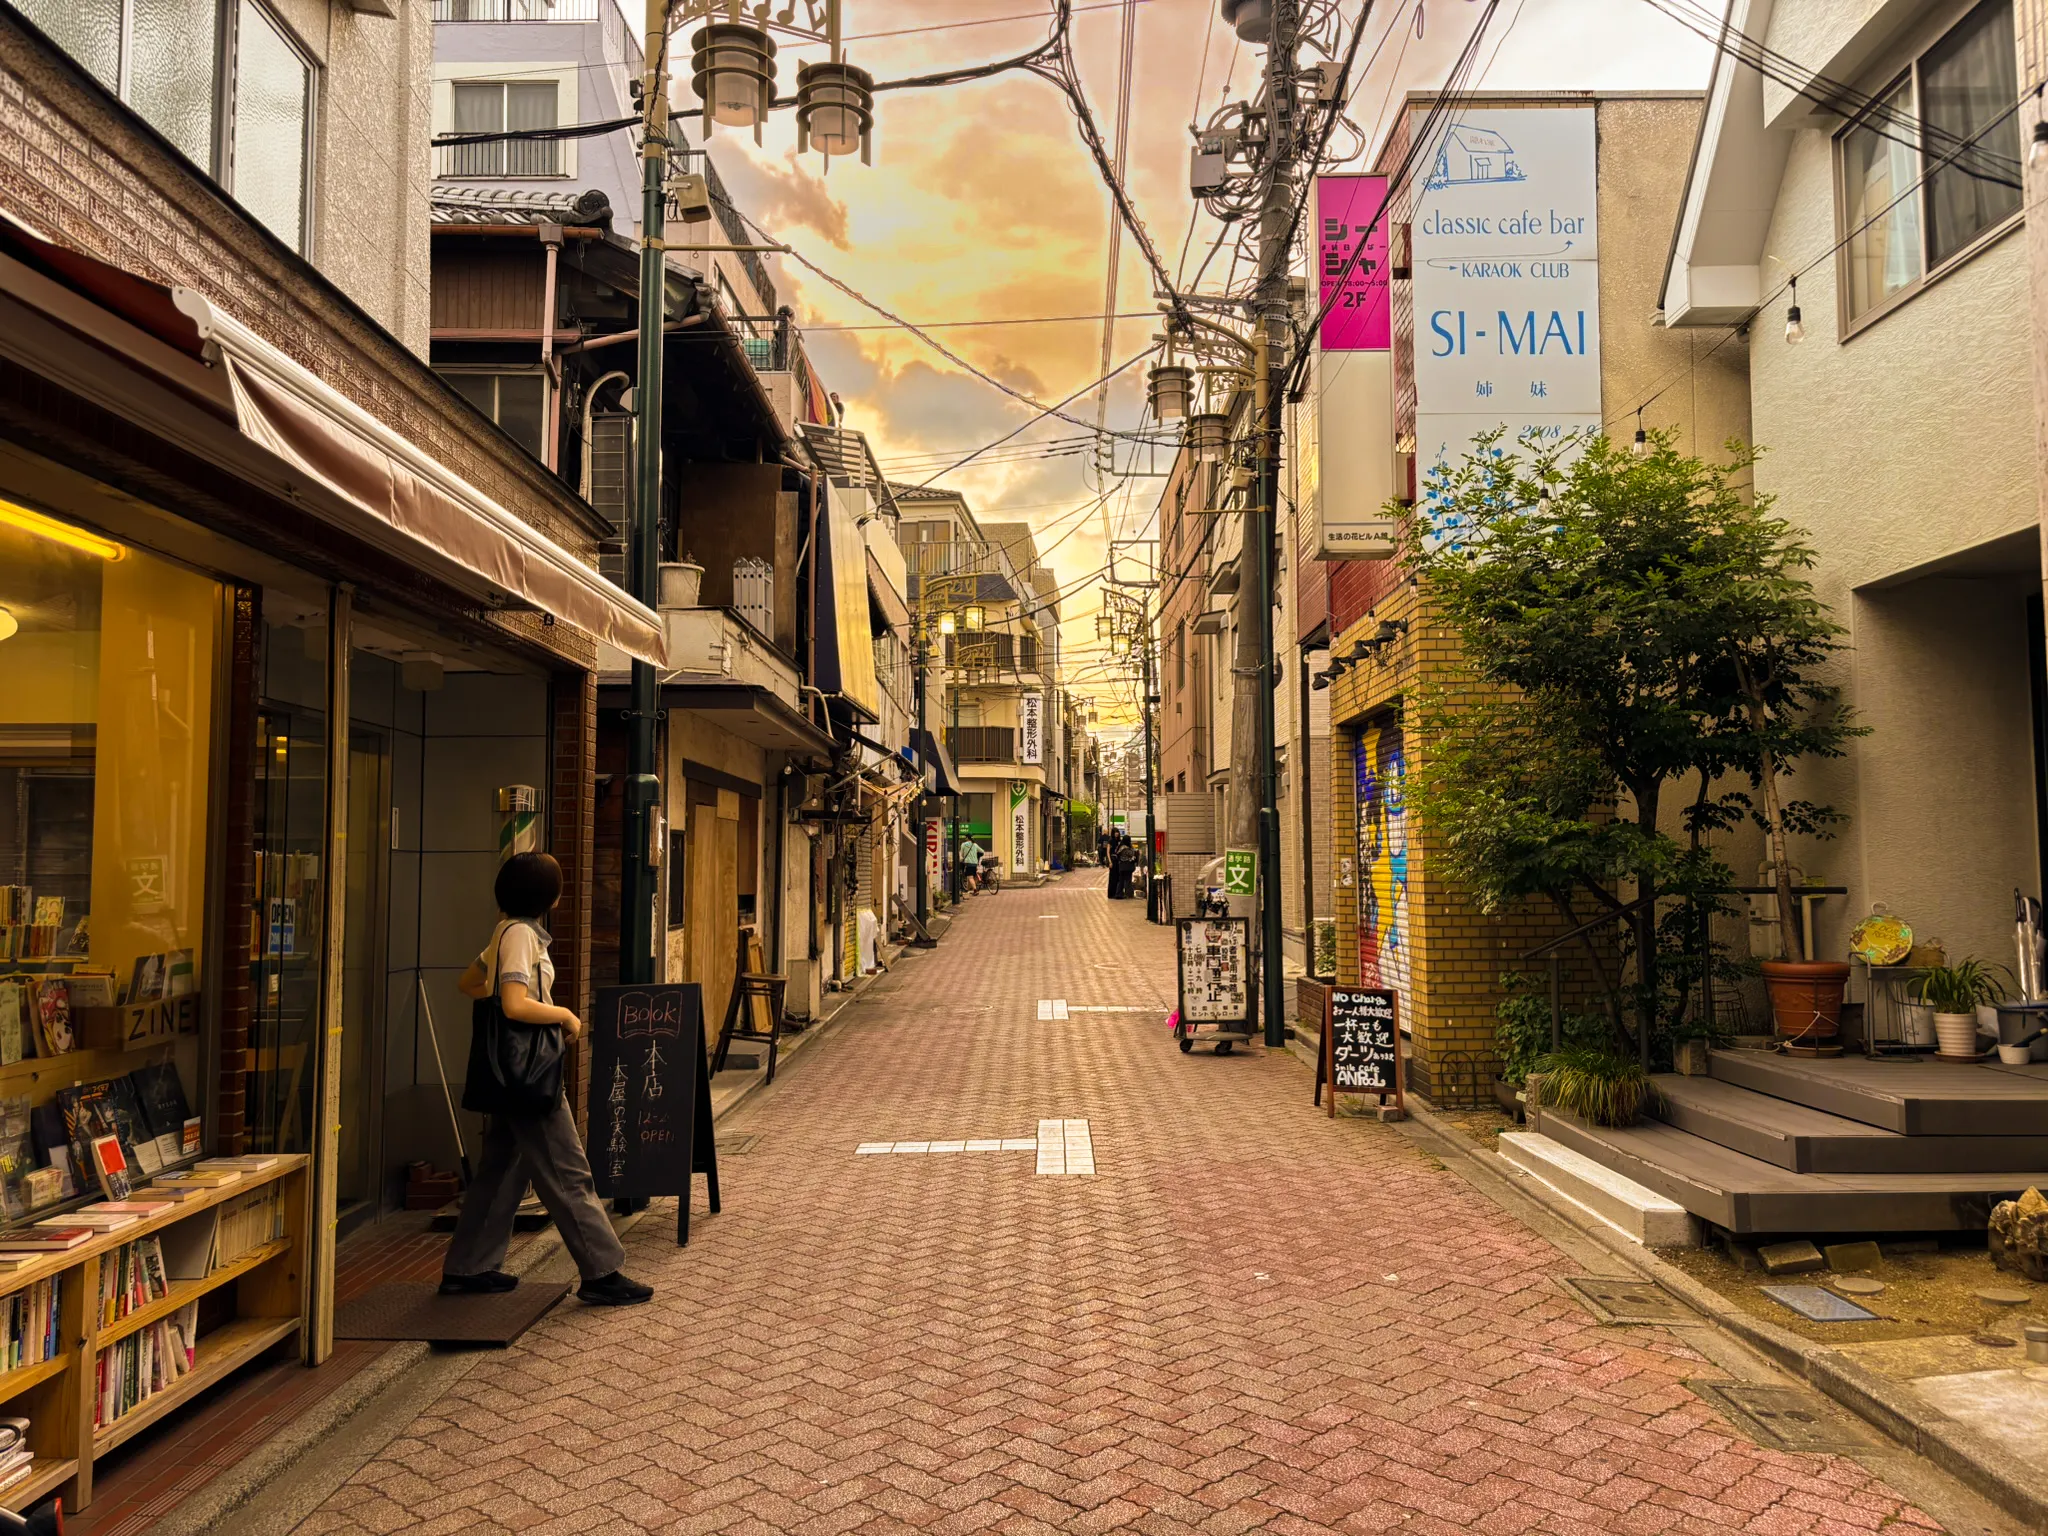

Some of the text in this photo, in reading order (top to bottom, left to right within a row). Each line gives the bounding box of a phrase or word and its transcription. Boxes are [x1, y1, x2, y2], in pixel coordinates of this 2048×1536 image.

[1325, 218, 1378, 240] シー
[1423, 209, 1585, 234] classic cafe bar
[1325, 252, 1376, 275] シャ
[1461, 262, 1570, 278] KARAOK CLUB
[1343, 291, 1367, 308] 2F
[1026, 697, 1038, 760] 松本整形外科
[1015, 814, 1025, 867] 松本整形外科
[1228, 854, 1251, 864] 通学路
[1228, 863, 1250, 888] 文
[1332, 992, 1387, 1006] NO Charge
[129, 1000, 191, 1041] ZINE
[1333, 1018, 1382, 1031] 一杯でも
[1340, 1031, 1394, 1048] 大歓迎
[641, 1039, 668, 1099] 本店
[606, 1056, 629, 1178] 本屋の実験室
